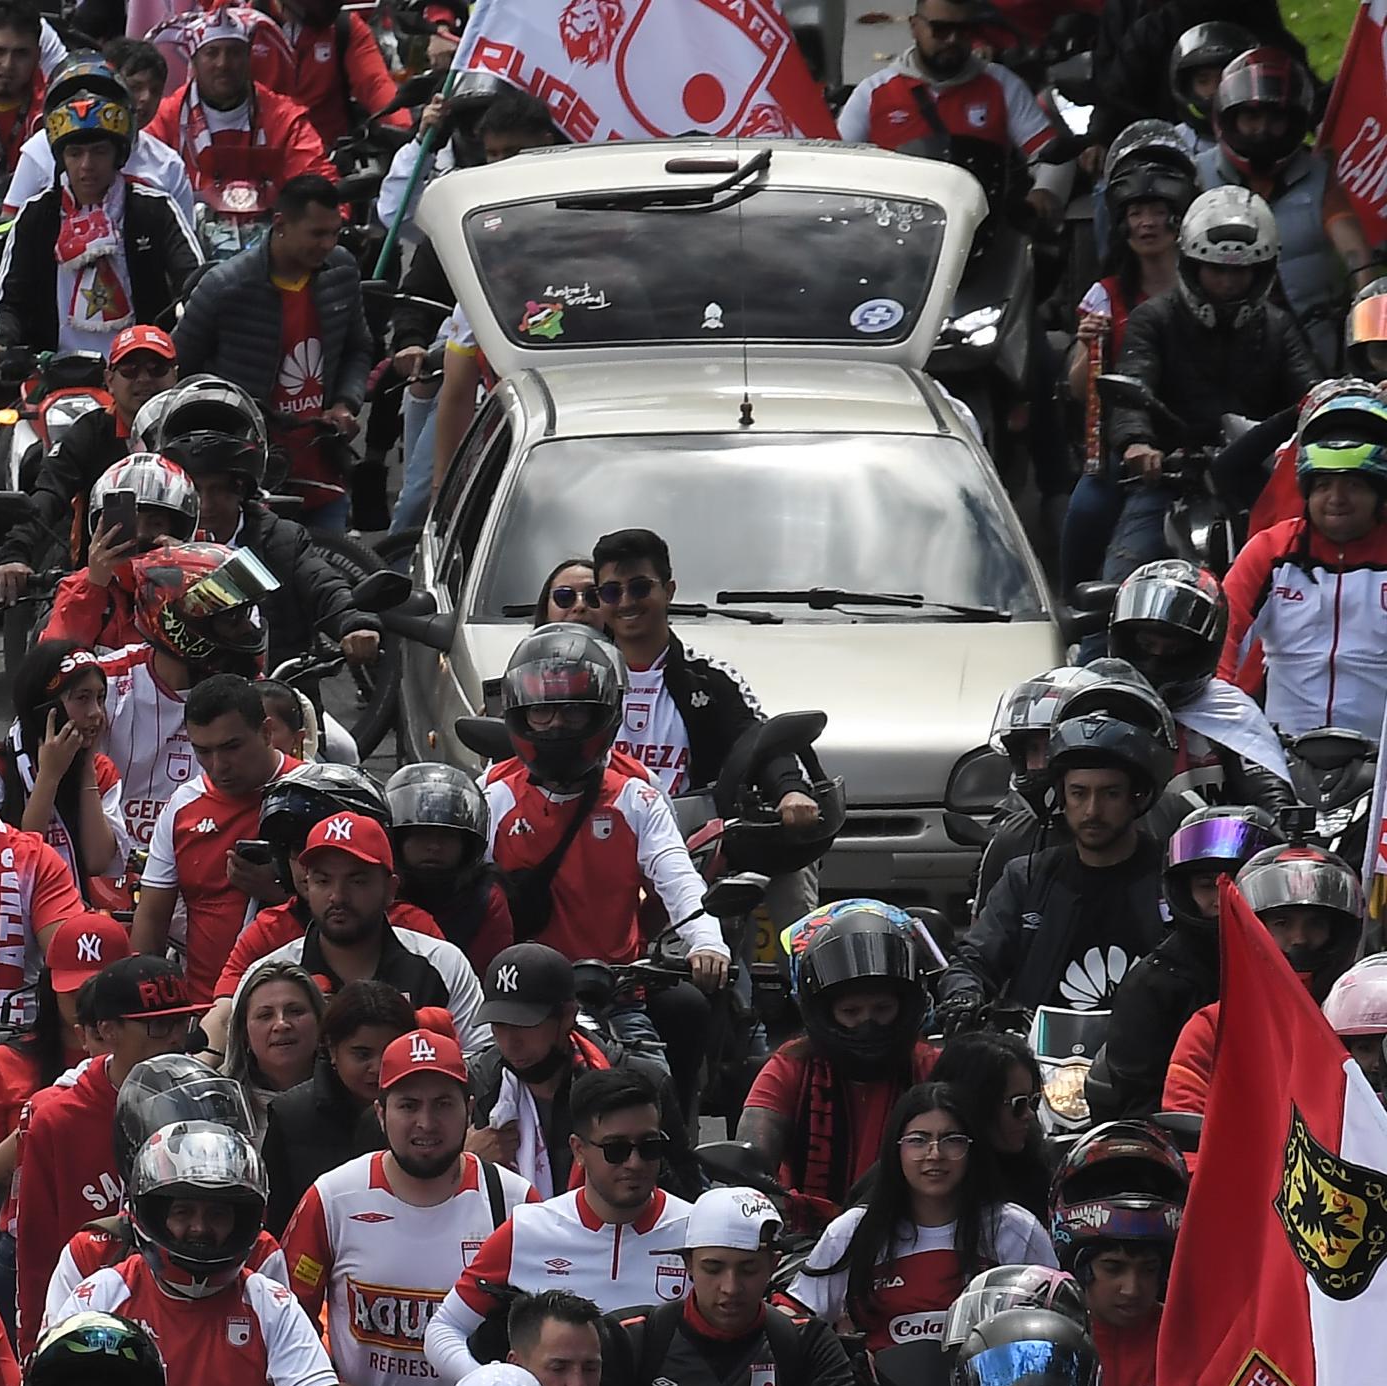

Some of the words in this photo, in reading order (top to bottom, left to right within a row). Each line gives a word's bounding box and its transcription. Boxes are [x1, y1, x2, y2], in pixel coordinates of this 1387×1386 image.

[468, 35, 599, 141] RUGE
[1276, 587, 1304, 601] FILA
[324, 817, 353, 840] NY
[77, 933, 102, 961] NY
[496, 965, 519, 992] NY
[409, 1034, 436, 1062] LA
[875, 1276, 905, 1290] FILA
